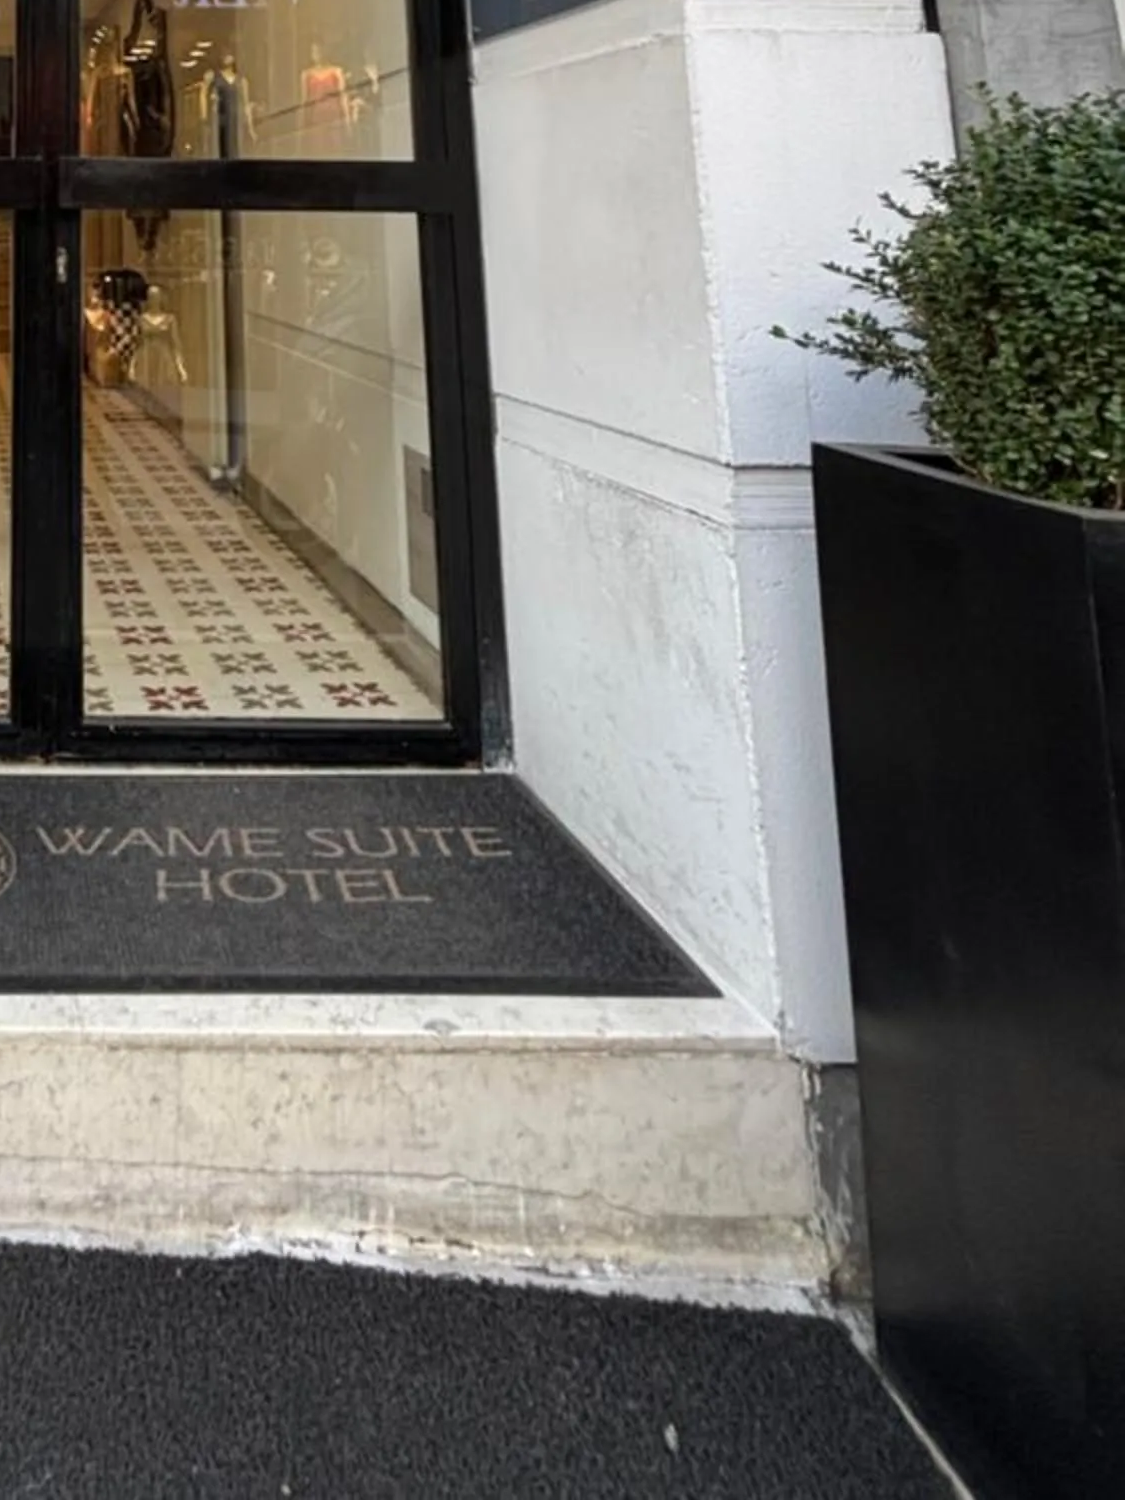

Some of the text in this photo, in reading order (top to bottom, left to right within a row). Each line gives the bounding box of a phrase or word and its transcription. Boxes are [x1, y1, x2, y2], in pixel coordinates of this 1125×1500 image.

[37, 826, 513, 857] WAME SUITE
[155, 868, 434, 902] HOTEL
